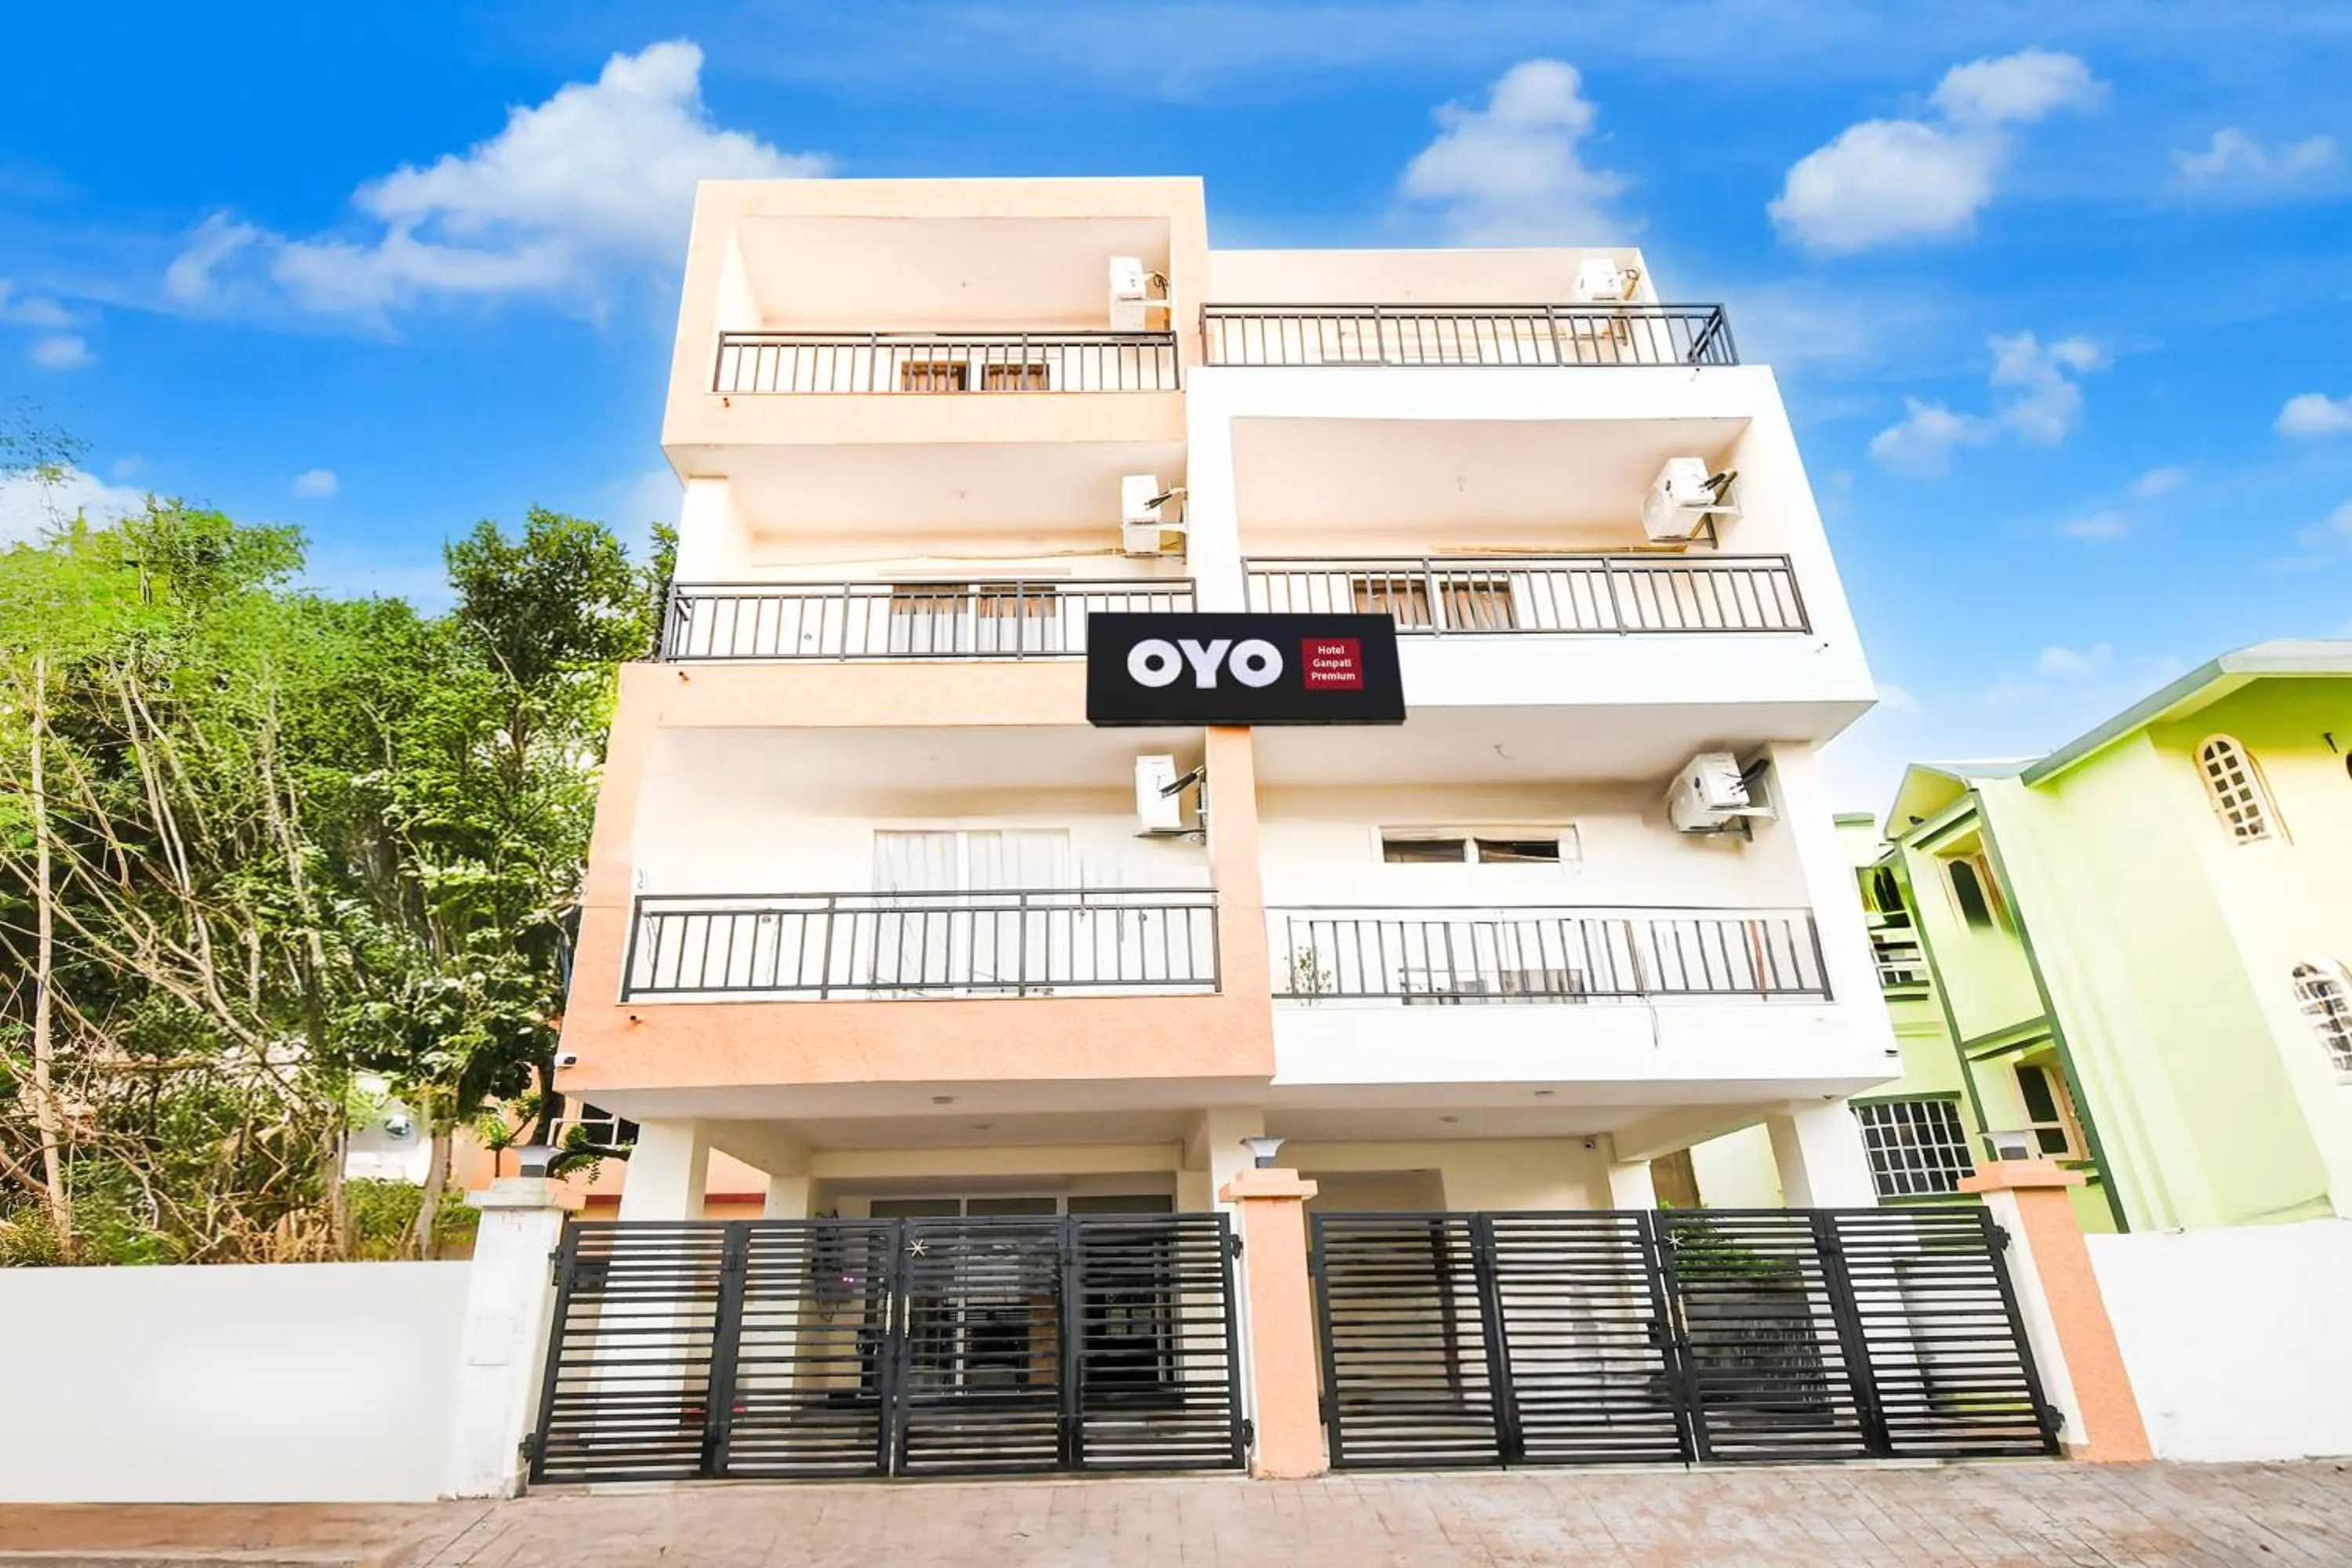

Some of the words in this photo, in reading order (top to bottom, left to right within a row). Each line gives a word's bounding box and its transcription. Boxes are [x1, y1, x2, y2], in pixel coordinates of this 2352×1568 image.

[1318, 645, 1345, 655] Hotel
[1127, 639, 1283, 688] OYO
[1312, 658, 1352, 670] Ganpati
[1311, 671, 1356, 681] Premium
